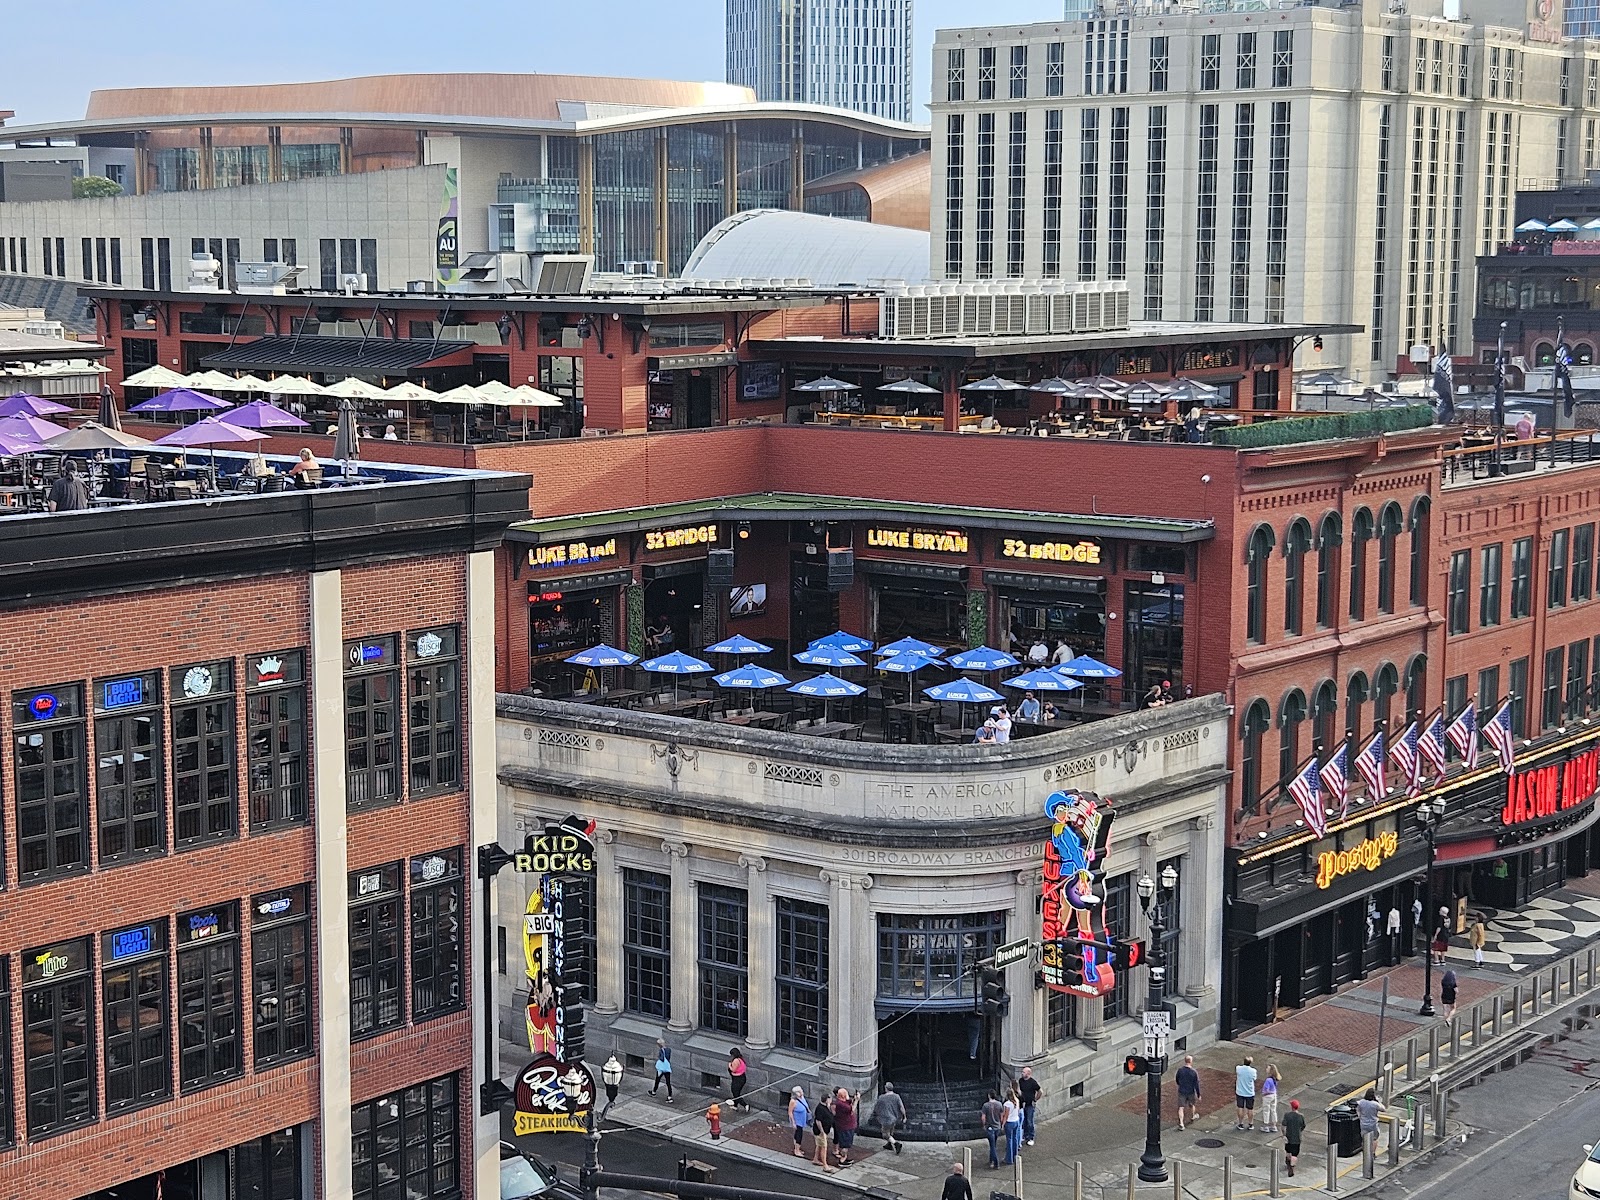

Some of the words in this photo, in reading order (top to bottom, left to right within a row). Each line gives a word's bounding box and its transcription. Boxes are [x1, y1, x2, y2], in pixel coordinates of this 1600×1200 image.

[440, 239, 455, 250] AU
[1116, 355, 1151, 375] JASON
[646, 532, 664, 550] 32
[665, 525, 716, 548] BRIDGE
[868, 529, 910, 548] LUKE
[912, 532, 968, 552] BRYAN
[528, 545, 566, 566] LUKE
[1003, 539, 1027, 557] 32
[1030, 542, 1100, 564] BRIDGE
[419, 643, 440, 653] BUSCH
[112, 682, 135, 694] BUD
[108, 690, 140, 706] LIGHT
[878, 784, 914, 798] THE
[926, 782, 1014, 799] AMERICAN
[1502, 765, 1559, 826] JASON
[875, 804, 965, 818] NATIONAL
[972, 801, 1015, 817] BANK
[532, 835, 578, 852] KID
[866, 850, 954, 864] BROADWAY
[964, 848, 1022, 864] BRANCH
[424, 864, 444, 876] BUSCH
[1043, 840, 1061, 940] LUKE'S
[534, 916, 552, 931] BIG
[554, 882, 564, 976] HONKY
[120, 932, 144, 945] BUD
[116, 940, 148, 956] LIGHT
[998, 944, 1028, 963] Broadway
[42, 956, 68, 976] Lite
[556, 986, 565, 1063] TONK
[1144, 1024, 1154, 1034] OK
